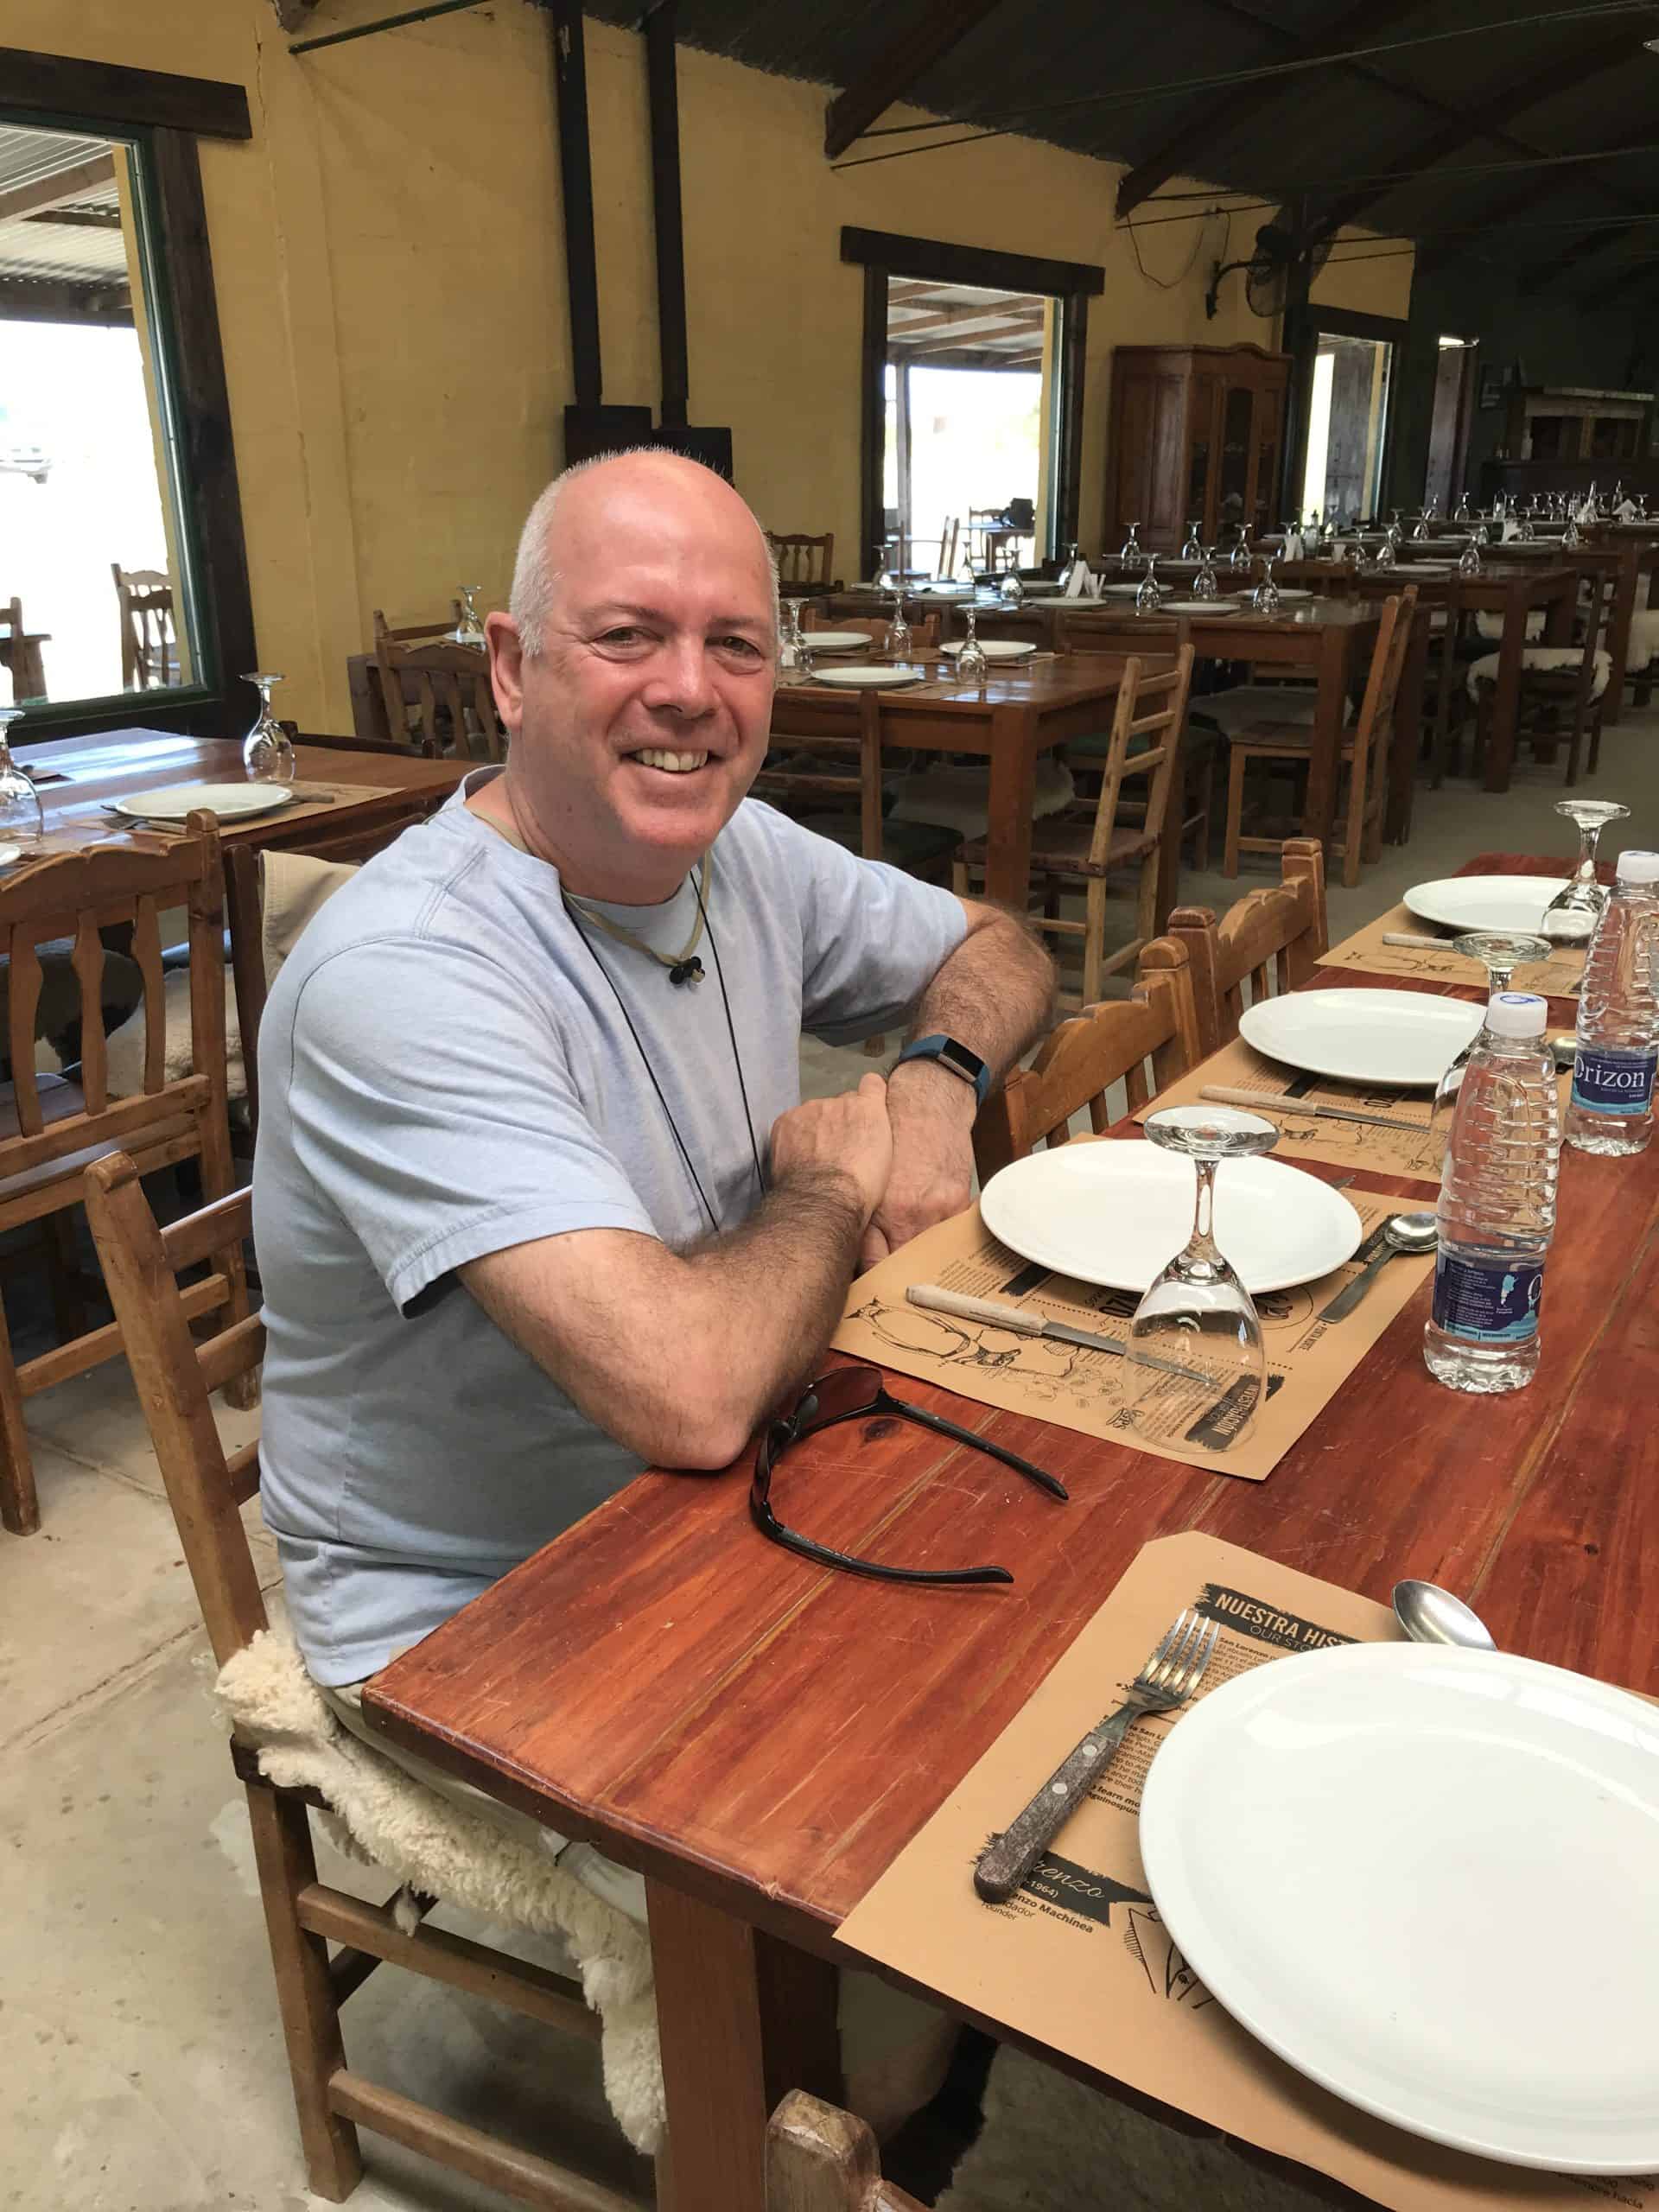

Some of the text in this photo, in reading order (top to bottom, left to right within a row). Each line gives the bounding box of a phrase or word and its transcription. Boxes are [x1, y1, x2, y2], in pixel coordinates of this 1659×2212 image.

[1215, 1593, 1300, 1637] NUESTRA
[1250, 1625, 1313, 1652] OUR STO
[1125, 1796, 1141, 1808] mo
